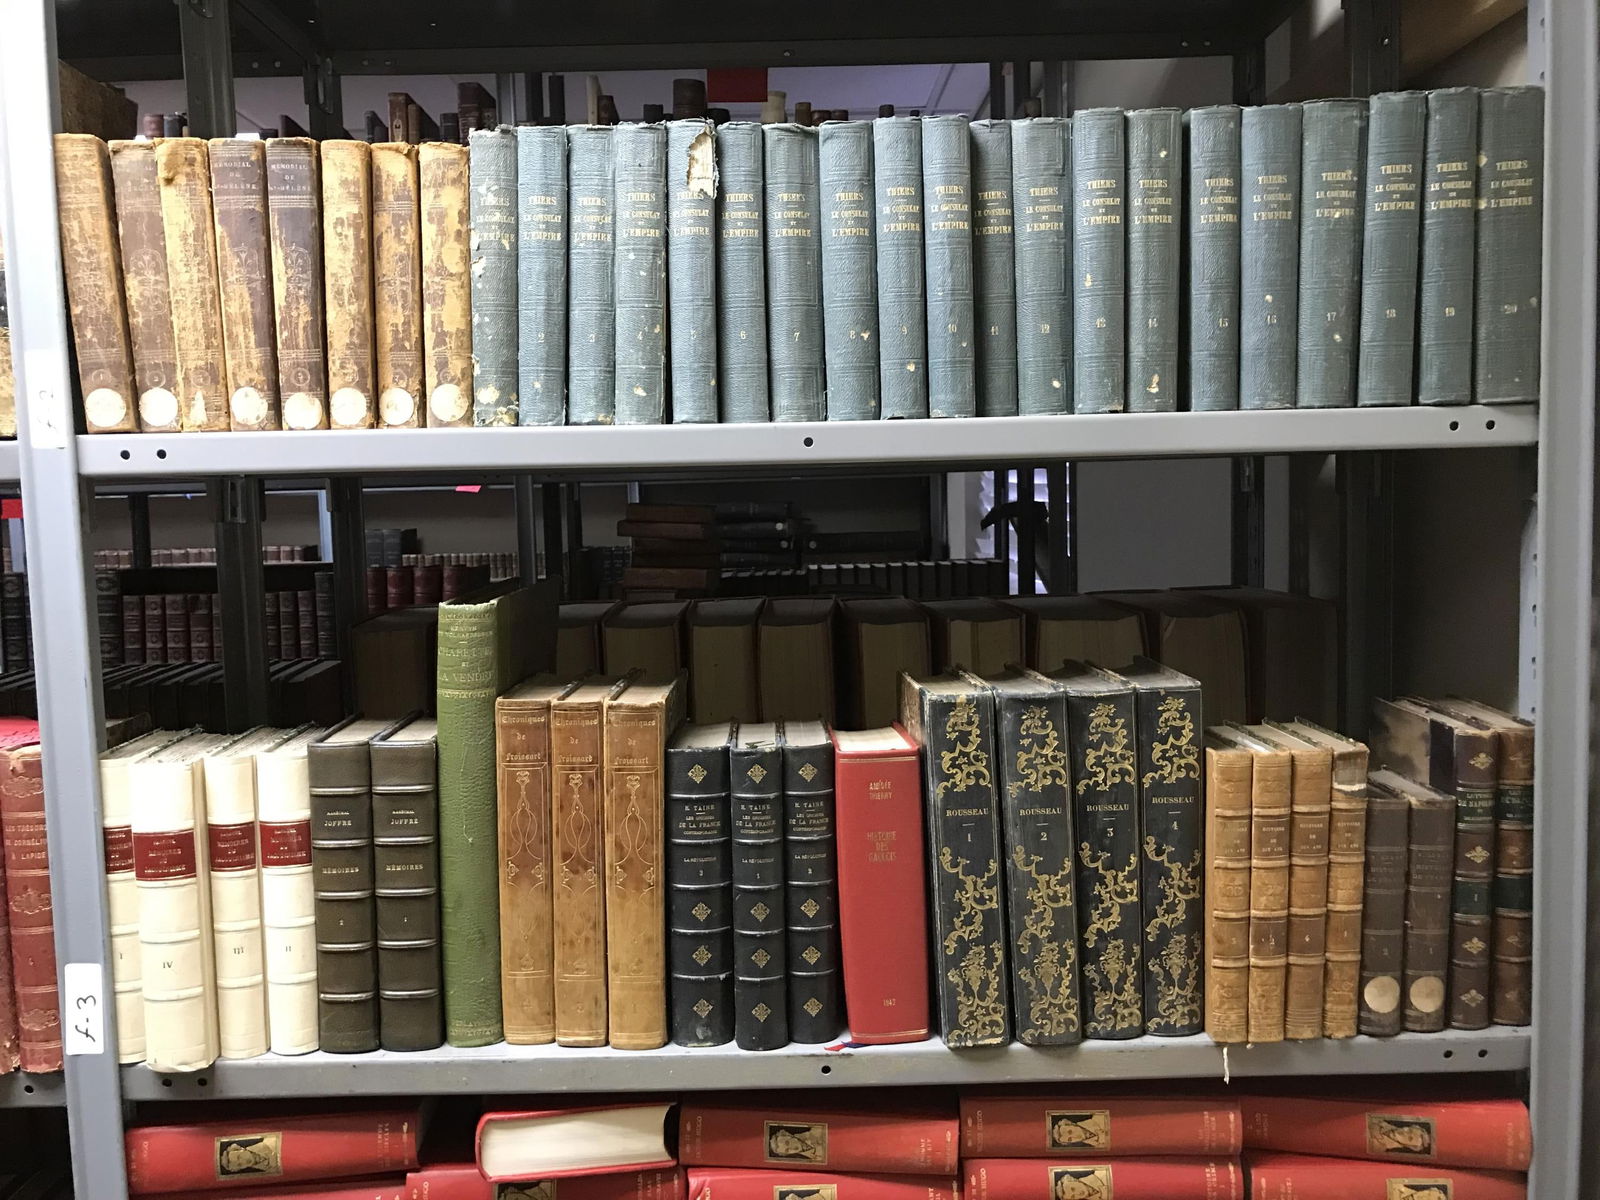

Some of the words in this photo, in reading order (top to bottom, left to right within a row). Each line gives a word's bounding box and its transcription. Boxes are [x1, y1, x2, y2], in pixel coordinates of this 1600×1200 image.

[1381, 164, 1412, 174] THIERS
[1436, 162, 1468, 173] THIERS
[1496, 160, 1528, 170] THIERS
[1258, 175, 1288, 184] THIERS
[1322, 172, 1351, 181] THIERS
[1088, 180, 1116, 189] THIERS
[1139, 180, 1168, 188] THIERS
[1205, 178, 1234, 187] THIERS
[1431, 183, 1440, 191] LE
[1442, 181, 1472, 190] CONSULAT
[1502, 178, 1533, 187] CONSULAT
[887, 187, 914, 196] THIERS
[935, 186, 963, 195] THIERS
[1029, 187, 1058, 196] THIERS
[1375, 184, 1384, 192] LE
[628, 192, 655, 201] THIERS
[726, 194, 754, 202] THIERS
[778, 193, 805, 201] THIERS
[836, 192, 864, 201] THIERS
[978, 191, 1007, 200] THIERS
[529, 196, 556, 205] THIERS
[581, 198, 606, 206] THIERS
[1092, 198, 1120, 206] CONSULAT
[1431, 199, 1472, 210] L'EMPIRE
[1491, 197, 1532, 208] L'EMPIRE
[892, 205, 919, 213] CONSULAT
[940, 204, 968, 212] CONSULAT
[1375, 202, 1415, 211] L'EMPIRE
[1082, 216, 1120, 225] L'EMPIRE
[1135, 215, 1172, 224] L'EMPIRE
[1200, 214, 1237, 224] L'EMPIRE
[1254, 211, 1292, 221] L'EMPIRE
[883, 223, 920, 232] L'EMPIRE
[932, 222, 969, 231] L'EMPIRE
[975, 226, 1012, 236] L'EMPIRE
[1026, 222, 1064, 232] L'EMPIRE
[524, 232, 562, 240] L'EMPIRE
[624, 228, 659, 237] L'EMPIRE
[674, 227, 710, 236] L'EMPIRE
[723, 229, 759, 238] L'EMPIRE
[775, 228, 811, 238] L'EMPIRE
[832, 228, 869, 237] L'EMPIRE
[574, 232, 612, 241] L'EMPIRE
[1386, 309, 1396, 318] 18
[1445, 307, 1455, 316] 19
[1267, 315, 1277, 324] 16
[1326, 312, 1336, 321] 17
[1148, 319, 1158, 328] 14
[1219, 318, 1228, 327] 15
[902, 326, 907, 334] 9
[948, 324, 957, 333] 10
[990, 326, 998, 335] 11
[1040, 324, 1050, 333] 12
[537, 332, 545, 342] 2
[589, 334, 596, 342] 3
[637, 331, 643, 340] 4
[691, 330, 697, 340] 5
[740, 330, 746, 340] 6
[794, 332, 800, 342] 7
[850, 330, 856, 339] 8
[502, 715, 545, 725] Chroniques
[556, 718, 599, 727] Chroniques
[612, 720, 656, 729] Chroniques
[1152, 796, 1195, 804] ROUSSEAU
[946, 807, 989, 817] ROUSSEAU
[1019, 807, 1062, 816] ROUSSEAU
[1087, 804, 1129, 812] ROUSSEAU
[1171, 820, 1179, 831] 4
[867, 831, 896, 840] HISTOIRE
[1040, 831, 1048, 841] 2
[1107, 828, 1114, 837] 3
[967, 833, 972, 842] 1
[876, 842, 888, 851] DES
[869, 852, 896, 861] GAULOIS
